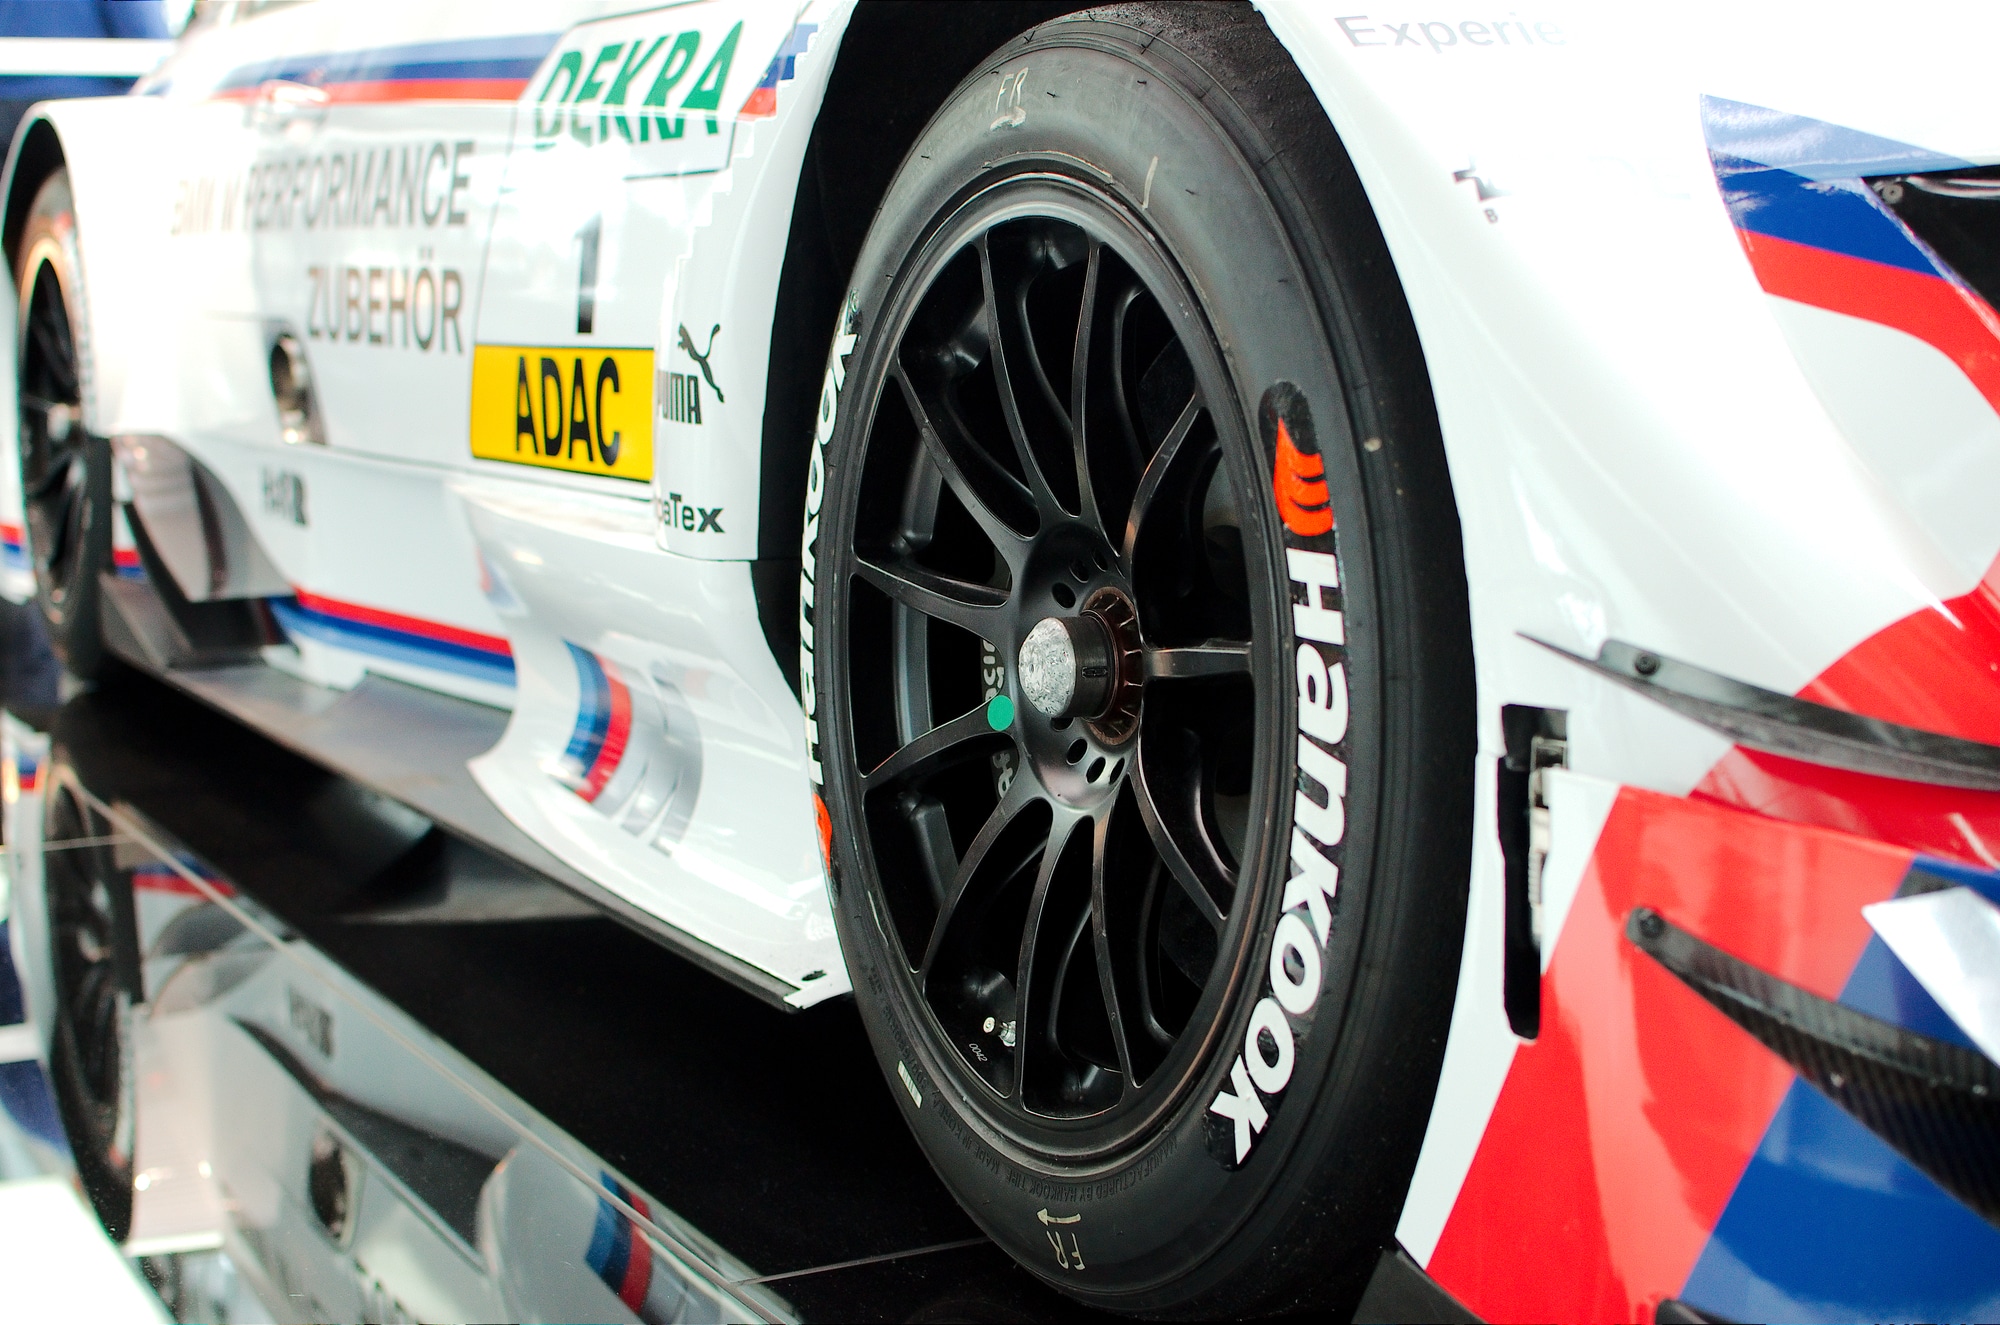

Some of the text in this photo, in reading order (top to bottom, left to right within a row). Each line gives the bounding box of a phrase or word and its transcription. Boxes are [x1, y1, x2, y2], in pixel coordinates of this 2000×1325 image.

[535, 20, 743, 149] DEKRA
[995, 66, 1029, 113] FR
[246, 140, 475, 231] PERFORMANCE
[306, 245, 464, 354] ZUBEHÖR
[573, 210, 603, 334] 1
[516, 356, 620, 467] ADAC
[1208, 548, 1350, 1165] Hankook
[968, 1042, 988, 1062] 0042
[1029, 1181, 1078, 1203] HANKOOK
[1094, 1136, 1178, 1198] MANUFACTURED
[1046, 1230, 1086, 1270] FR
